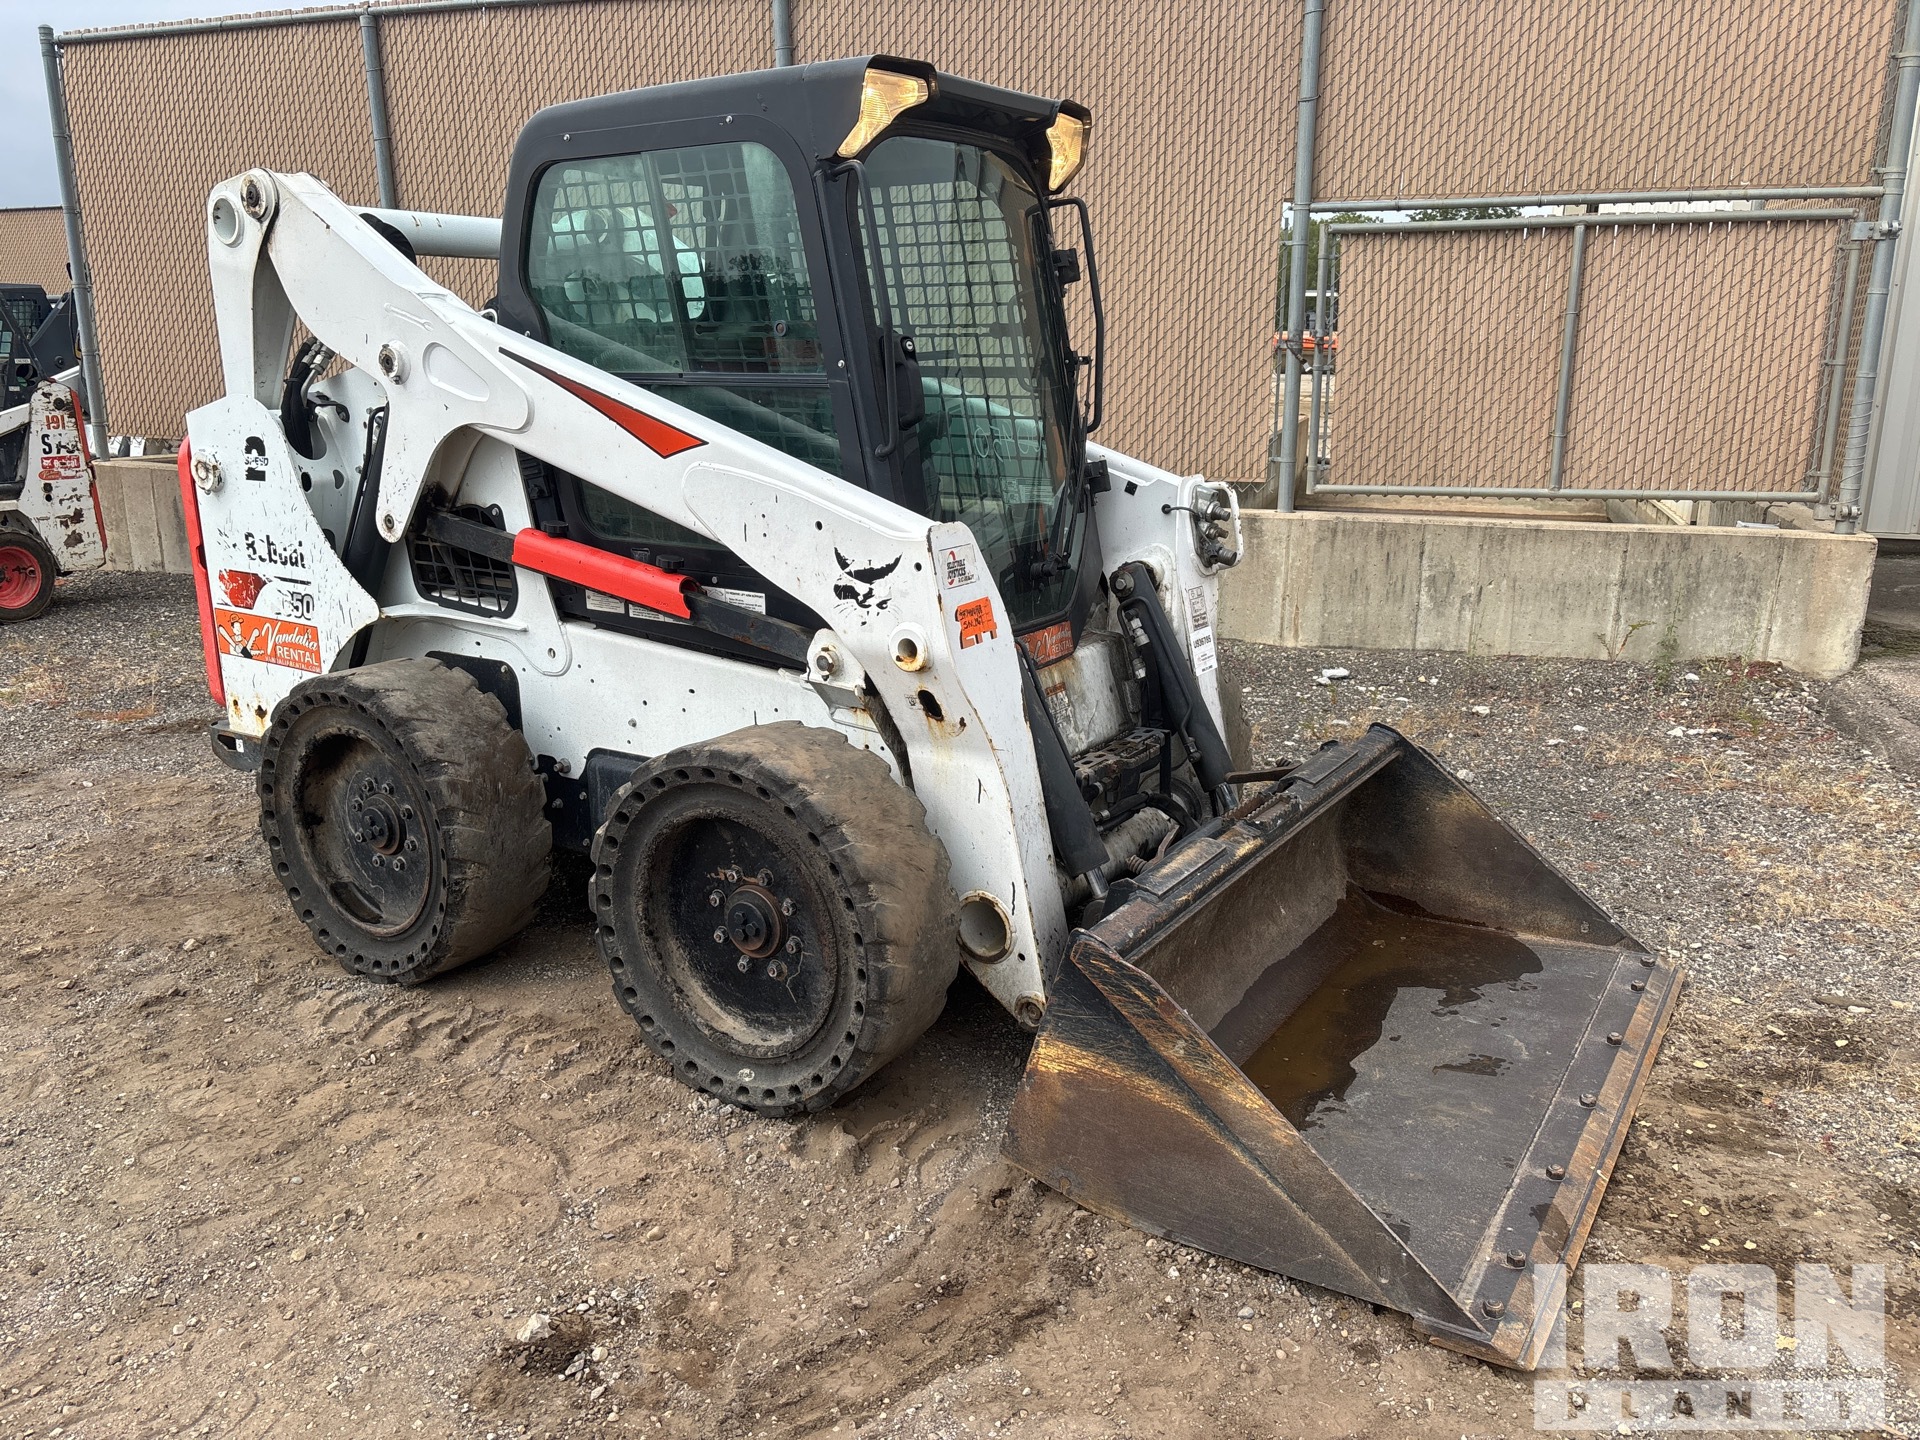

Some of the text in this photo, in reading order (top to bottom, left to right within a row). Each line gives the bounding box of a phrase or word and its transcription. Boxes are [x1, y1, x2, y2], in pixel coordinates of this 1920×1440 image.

[261, 621, 318, 655] Vandalia
[1051, 639, 1073, 654] RENTAL
[276, 645, 319, 666] RENTAL
